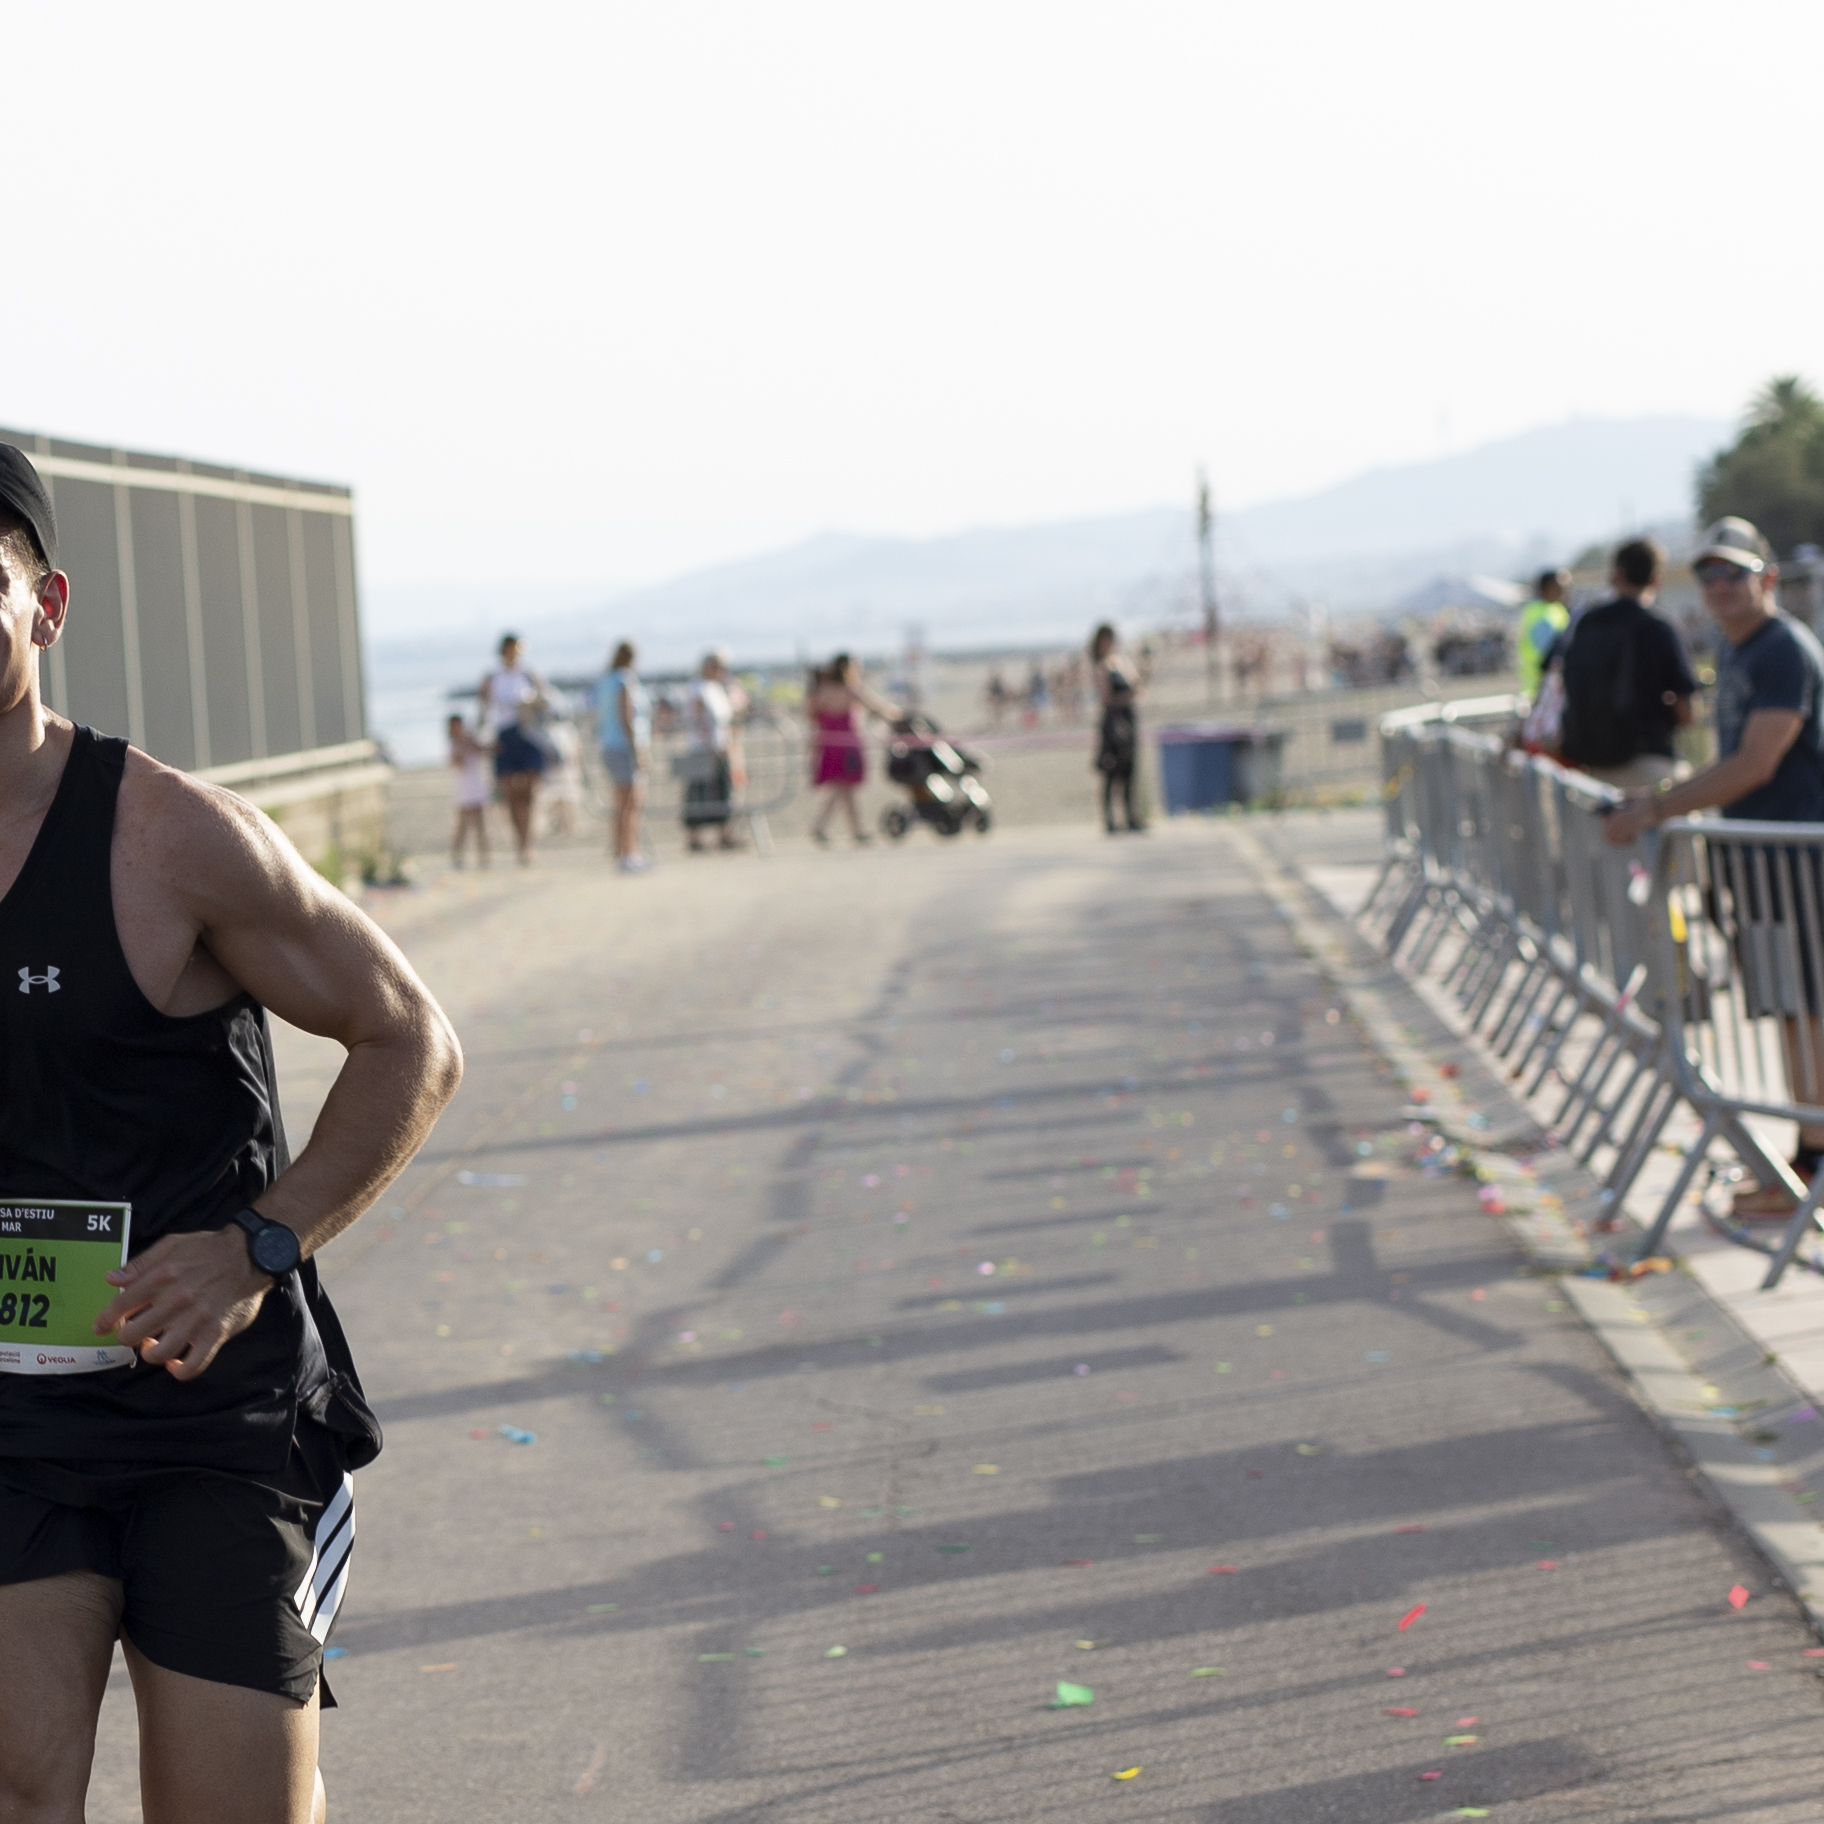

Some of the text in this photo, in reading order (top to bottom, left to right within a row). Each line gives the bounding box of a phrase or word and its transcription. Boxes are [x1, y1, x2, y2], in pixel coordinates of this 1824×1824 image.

[14, 1207, 55, 1220] D'ESTIU
[1, 1221, 22, 1232] MAR
[86, 1214, 112, 1232] 5K
[47, 1356, 76, 1364] VEOLIA
